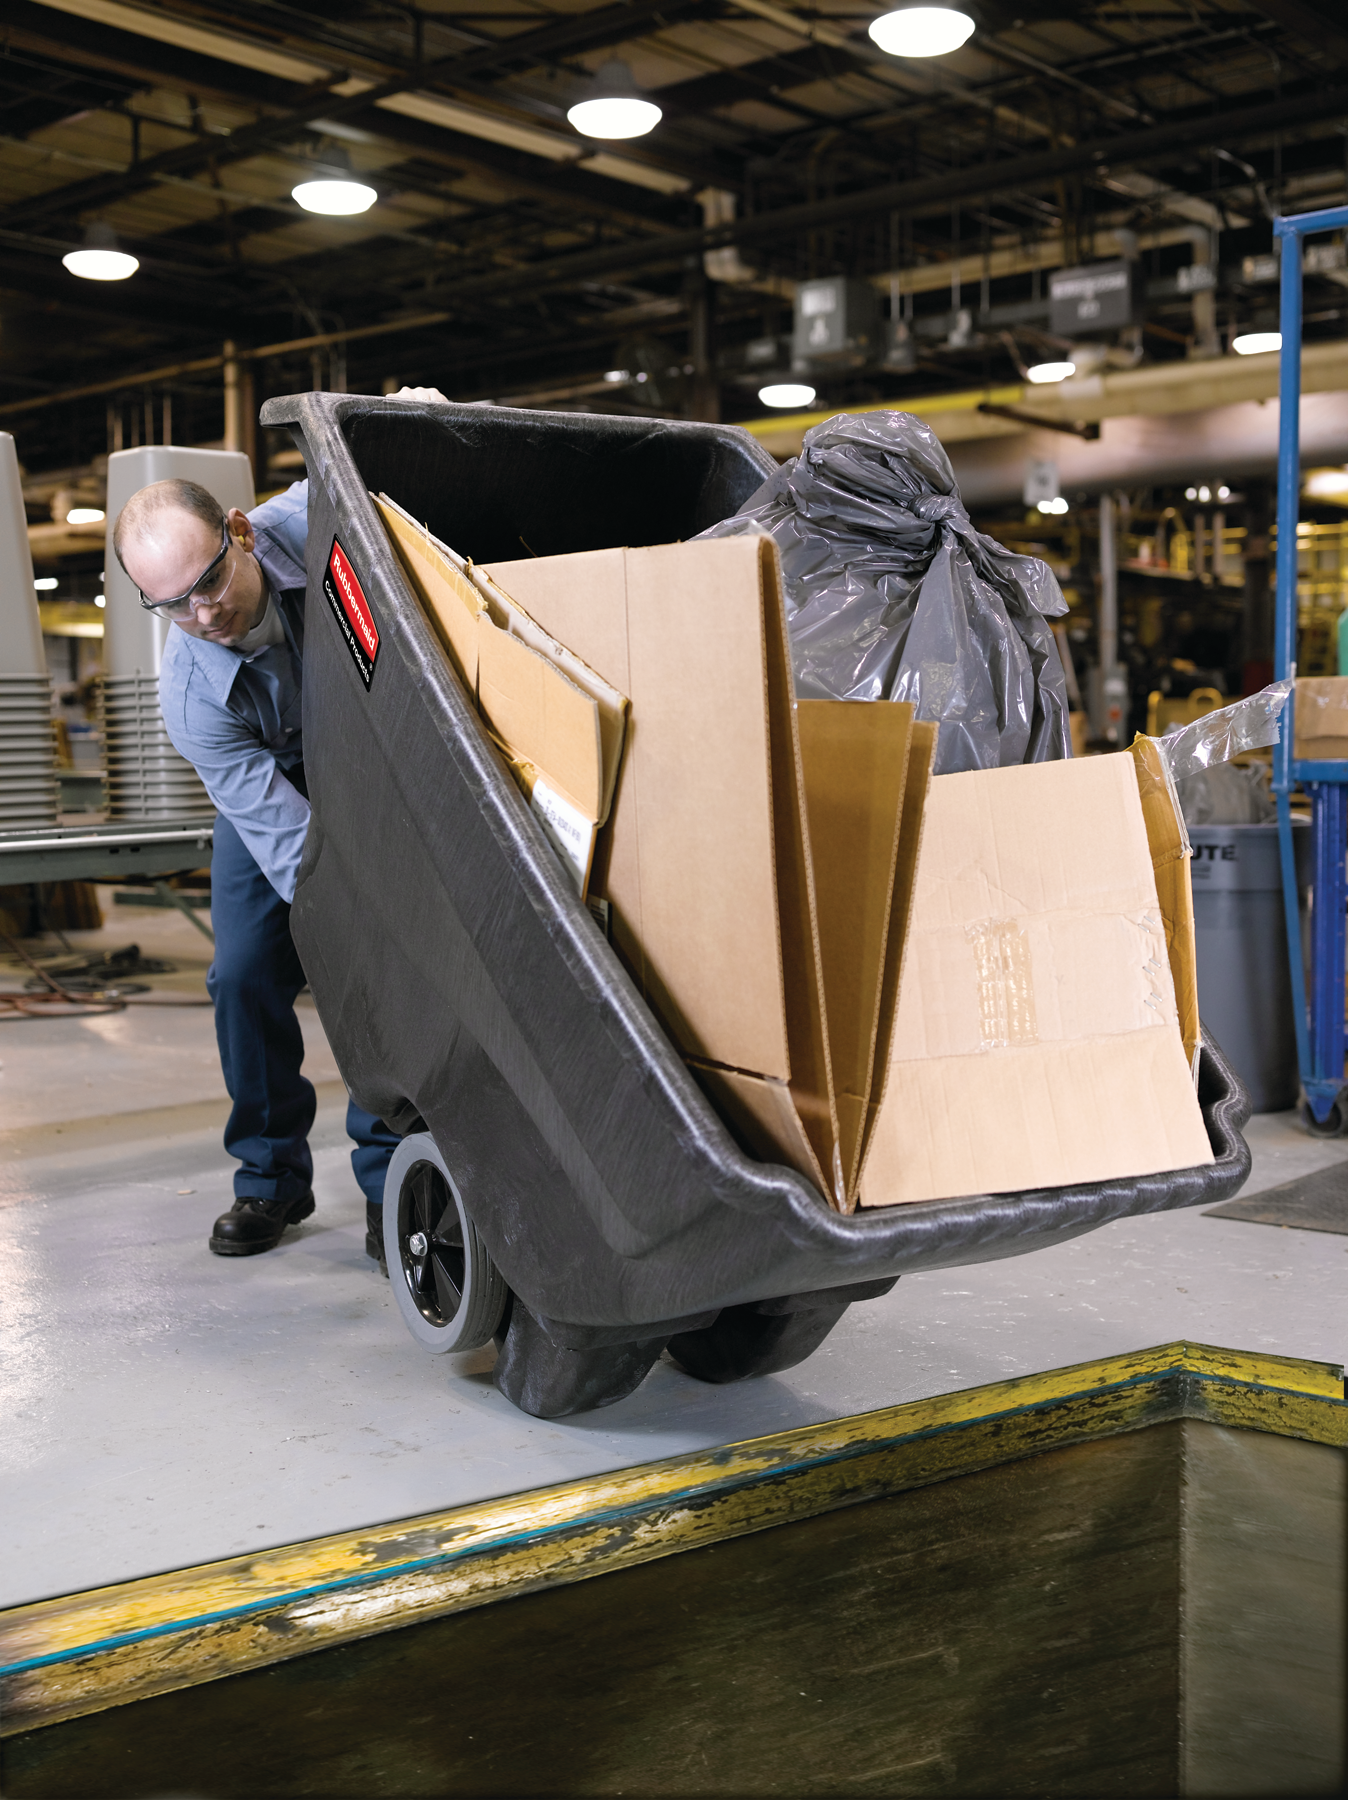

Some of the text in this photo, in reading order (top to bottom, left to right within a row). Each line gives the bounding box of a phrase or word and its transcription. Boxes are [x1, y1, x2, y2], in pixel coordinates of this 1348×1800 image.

[325, 580, 370, 683] Commercial Products
[333, 553, 376, 651] Rubbermaid
[1190, 844, 1236, 860] UTE
